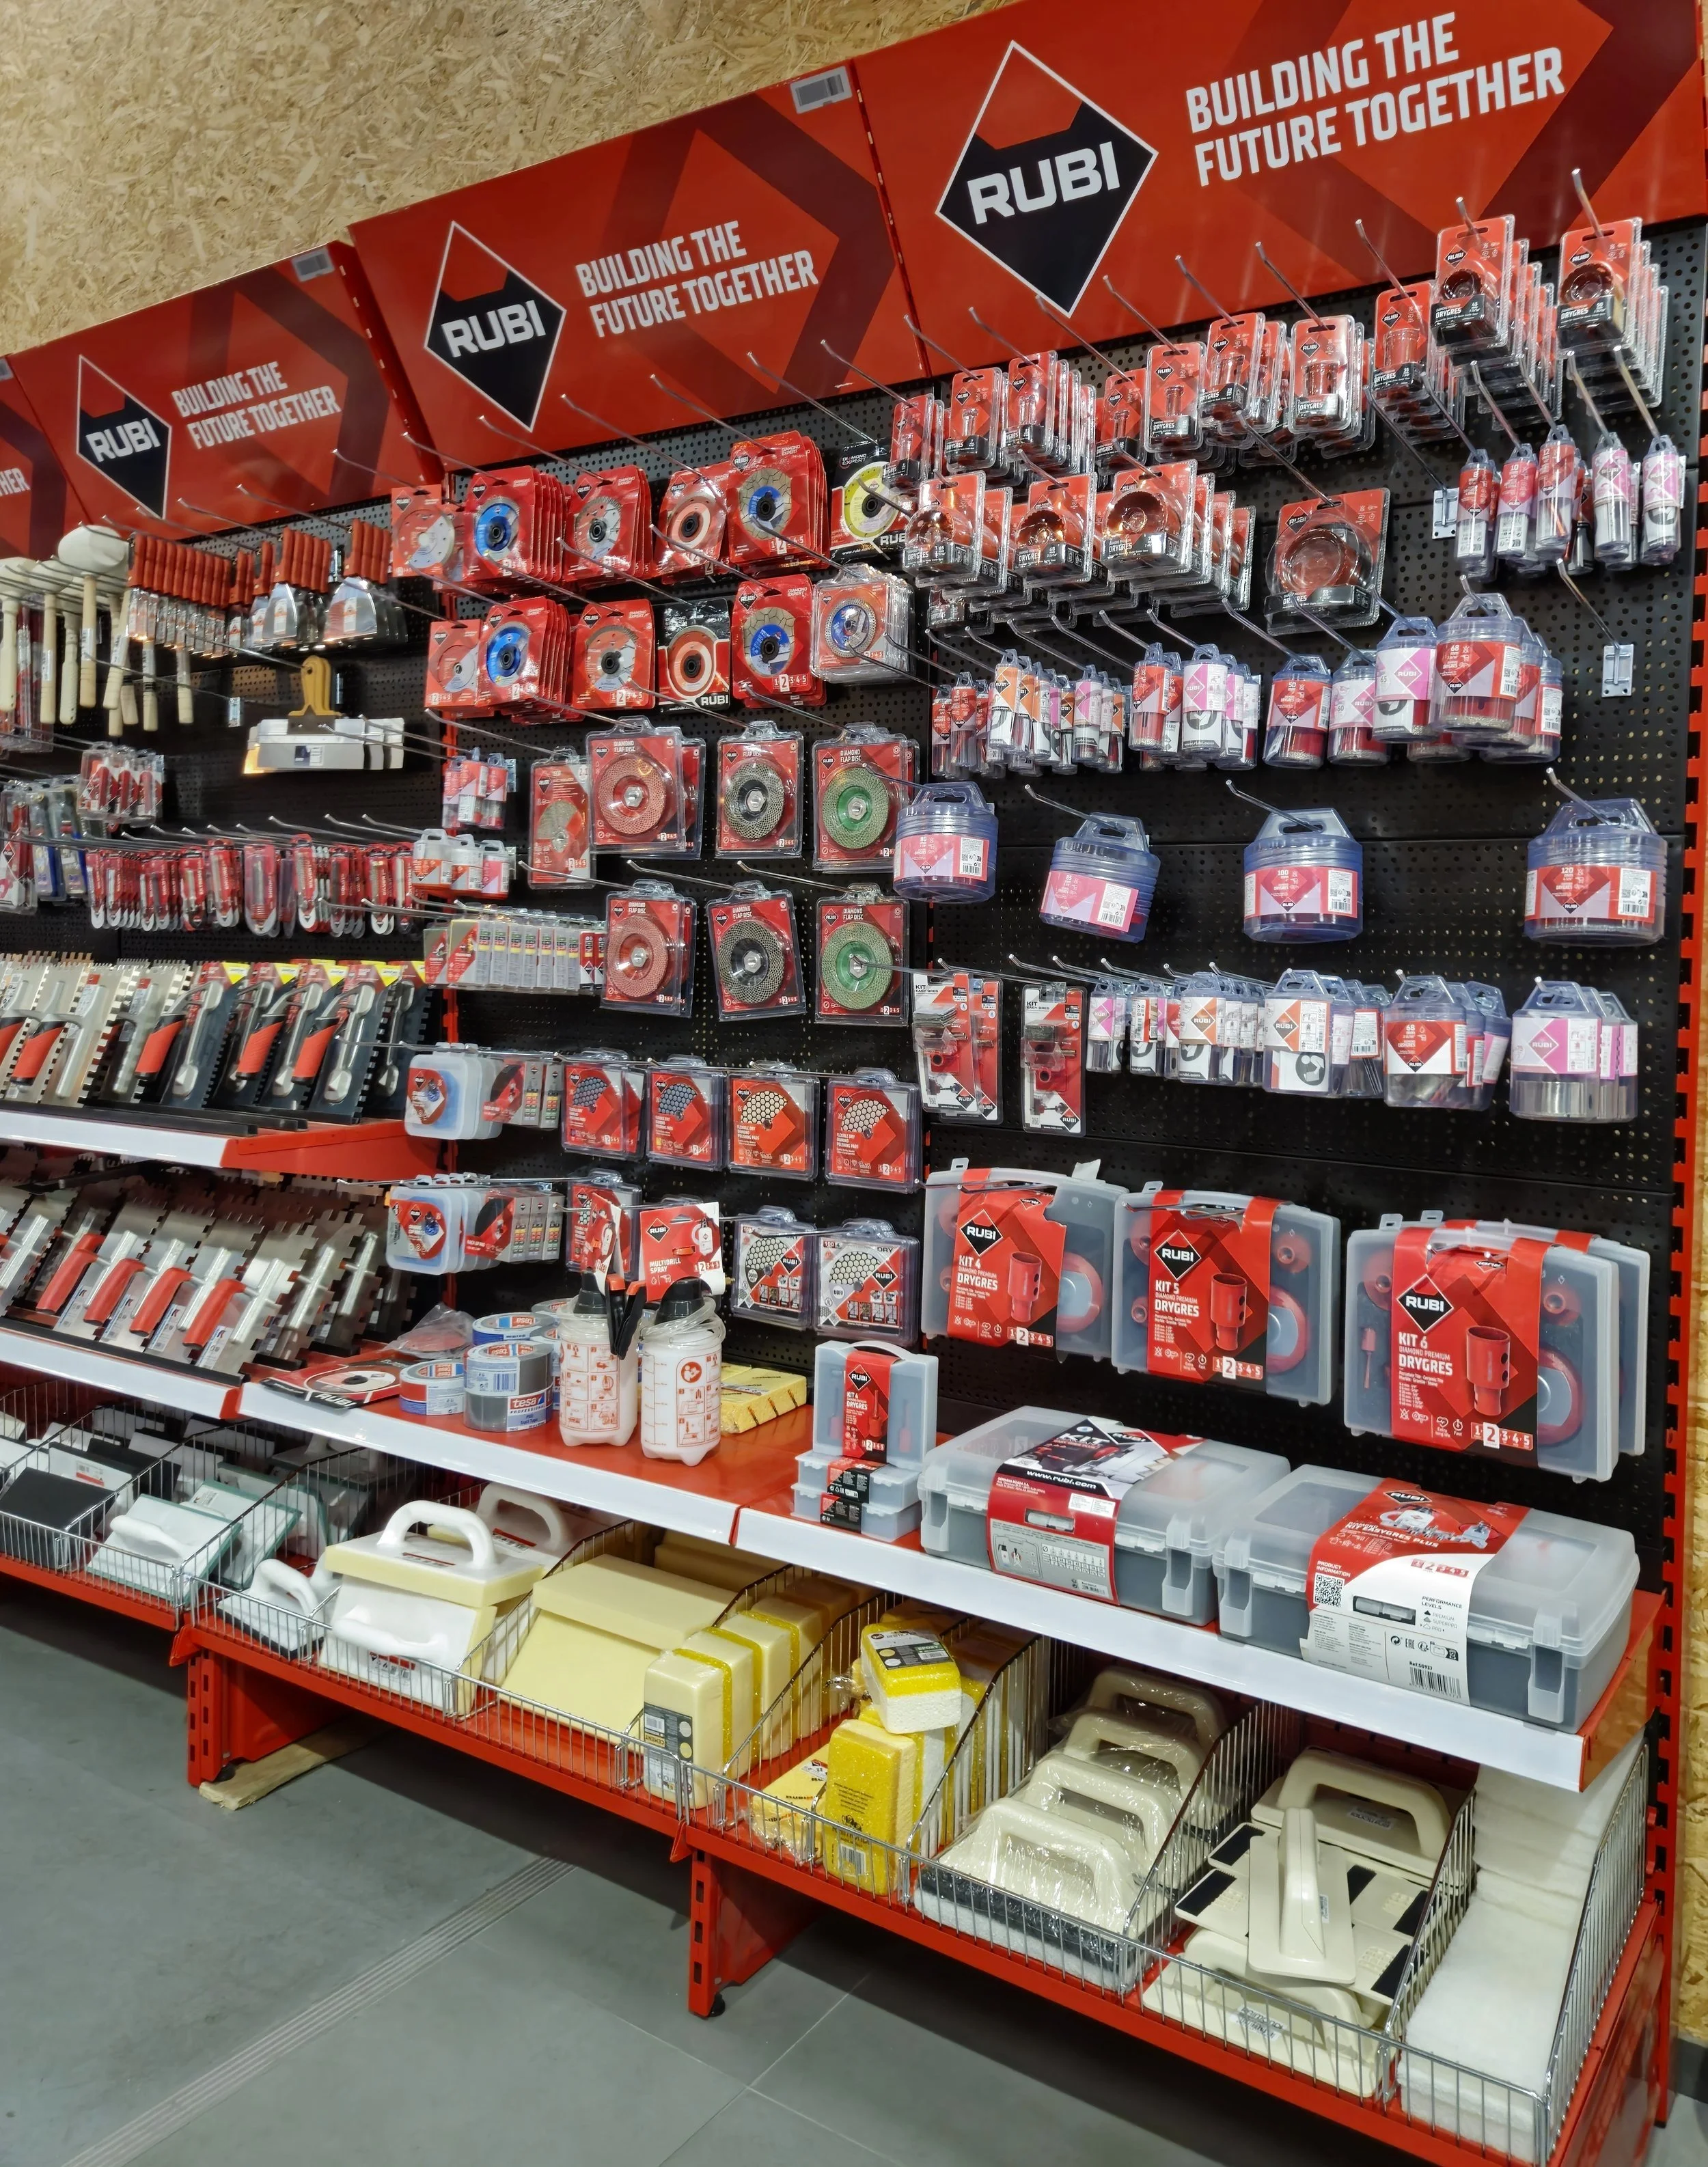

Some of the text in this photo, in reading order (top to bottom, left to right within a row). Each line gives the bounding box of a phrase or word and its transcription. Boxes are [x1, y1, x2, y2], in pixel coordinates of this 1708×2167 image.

[1186, 13, 1459, 133] BUILDING THE
[1194, 48, 1565, 187] FUTURE TOGETHER
[967, 142, 1120, 224] RUBI
[576, 221, 747, 298] BUILDING THE
[1572, 253, 1590, 262] RUBI
[590, 250, 819, 337] FUTURE TOGETHER
[1435, 308, 1461, 318] DRYGRES
[1561, 307, 1588, 318] DRYGRES
[441, 300, 546, 357] RUBI
[1374, 373, 1396, 383] DRYGRES
[171, 361, 288, 417] BUILDING THE
[1199, 391, 1220, 402] DRYGRES
[187, 385, 341, 449] FUTURE TOGETHER
[86, 418, 161, 461] RUBI
[842, 457, 867, 466] EXPERT
[880, 534, 906, 547] RUB
[1109, 543, 1133, 553] DRYGRES
[907, 553, 929, 562] DRYGRES
[1019, 553, 1041, 562] DRYGRES
[701, 694, 729, 706] RUBI
[732, 906, 751, 914] DIAMOND
[967, 1226, 995, 1240] RUBI
[1162, 1248, 1194, 1262] RUBI
[650, 1258, 681, 1268] MULTIDRILL
[959, 1255, 981, 1269] KIT 4
[958, 1267, 997, 1278] DIAMOND PREMIUM
[957, 1273, 998, 1290] DRYGRES
[1155, 1280, 1179, 1295] KIT 5
[1155, 1293, 1198, 1303] DIAMOND PREMIUM
[1405, 1295, 1444, 1312] RUBI
[1155, 1301, 1199, 1317] DRYGRES
[1399, 1331, 1428, 1349] KIT 6
[1399, 1346, 1450, 1361] DIAMOND PREMIUM
[1399, 1354, 1452, 1376] DRYGRES
[851, 1373, 868, 1381] RUBI
[315, 1391, 358, 1409] RUBI
[514, 1397, 536, 1407] tesa
[846, 1400, 868, 1410] DRYGRES
[510, 1404, 547, 1413] PROFESSIONAL
[1112, 1433, 1146, 1442] RUBI
[1026, 1469, 1097, 1489] www.rubi.com
[1390, 1492, 1425, 1502] RUBI
[1346, 1523, 1439, 1548] KIT EASYGRES PLUS
[1316, 1565, 1351, 1578] INFORMATION
[1317, 1560, 1342, 1571] PRODUCT
[1421, 1601, 1442, 1610] LEVELS
[1422, 1595, 1463, 1609] PERFORMANCE
[1433, 1612, 1455, 1621] PREMIUM
[1433, 1619, 1457, 1629] SUPERPRO
[645, 1735, 665, 1745] CEMENT
